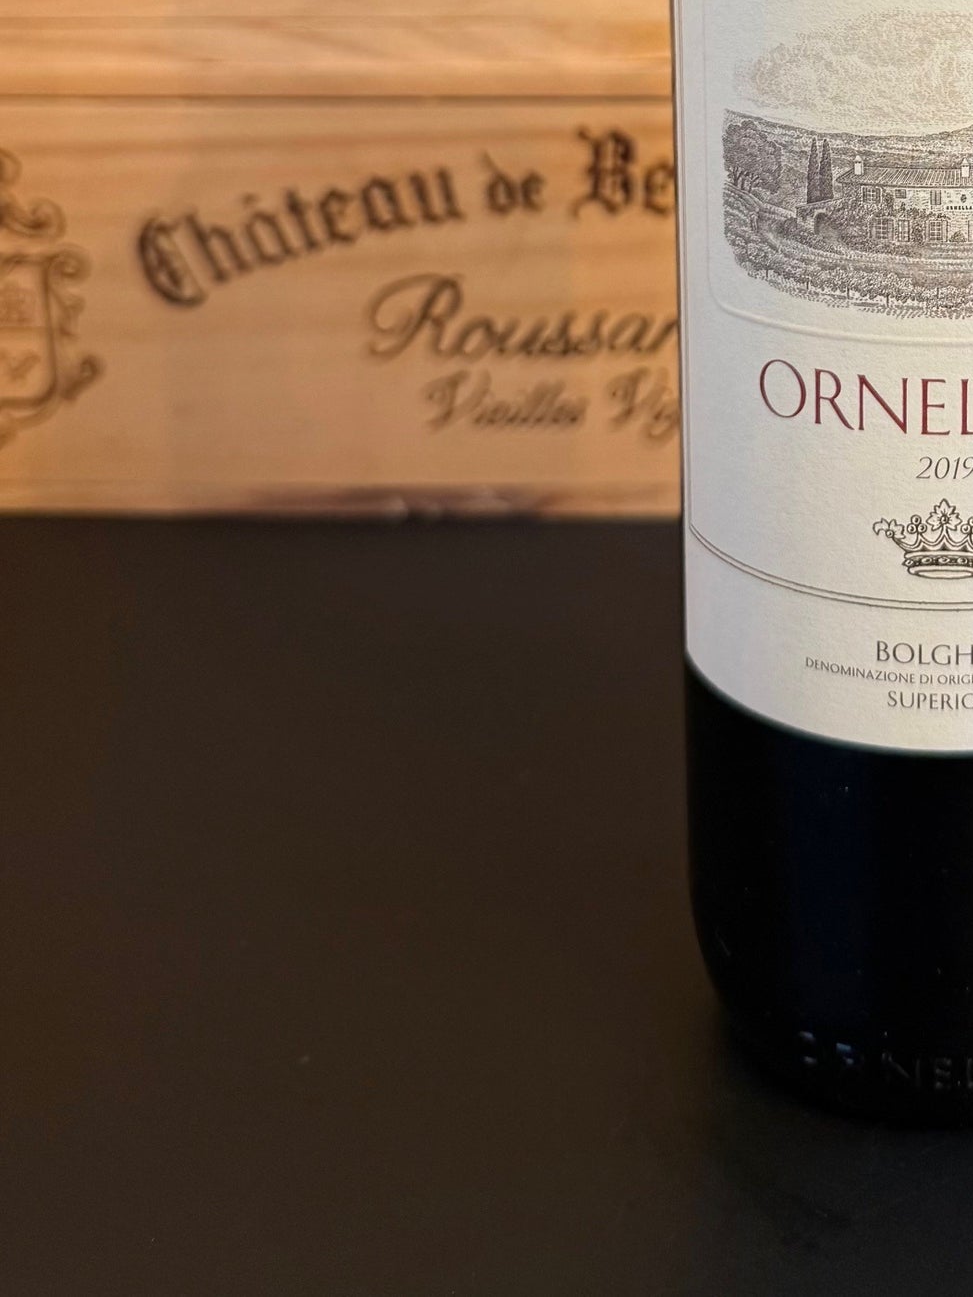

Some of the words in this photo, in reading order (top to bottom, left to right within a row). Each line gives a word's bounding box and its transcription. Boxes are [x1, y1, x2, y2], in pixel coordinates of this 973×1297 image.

[479, 150, 545, 217] de
[805, 656, 916, 684] DENOMINAZIONE
[919, 674, 933, 684] DI
